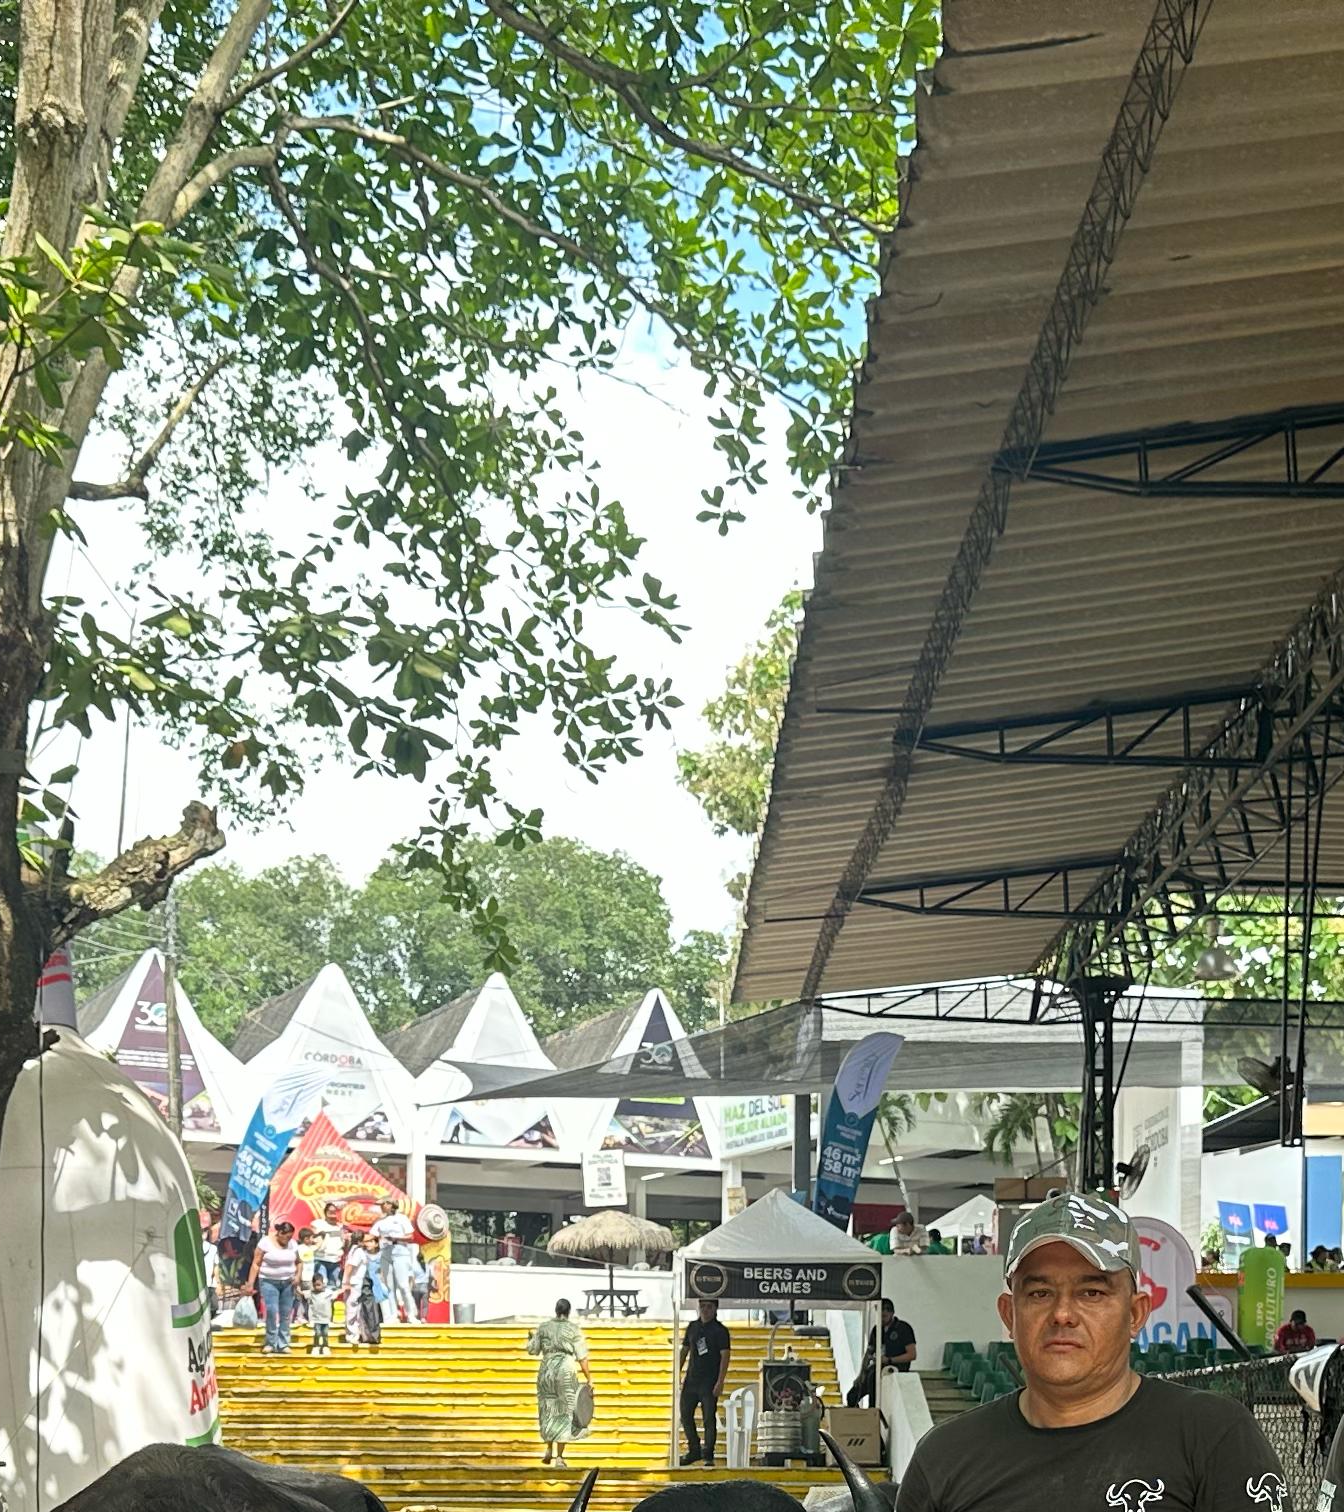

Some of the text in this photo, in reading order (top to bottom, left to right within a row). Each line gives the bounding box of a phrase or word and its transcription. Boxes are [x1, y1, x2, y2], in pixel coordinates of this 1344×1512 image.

[748, 1099, 766, 1118] DEL
[823, 1147, 840, 1162] 46
[743, 1267, 827, 1281] BEERS AND
[759, 1282, 811, 1294] GAMES
[1265, 1267, 1277, 1350] GROFUTURO
